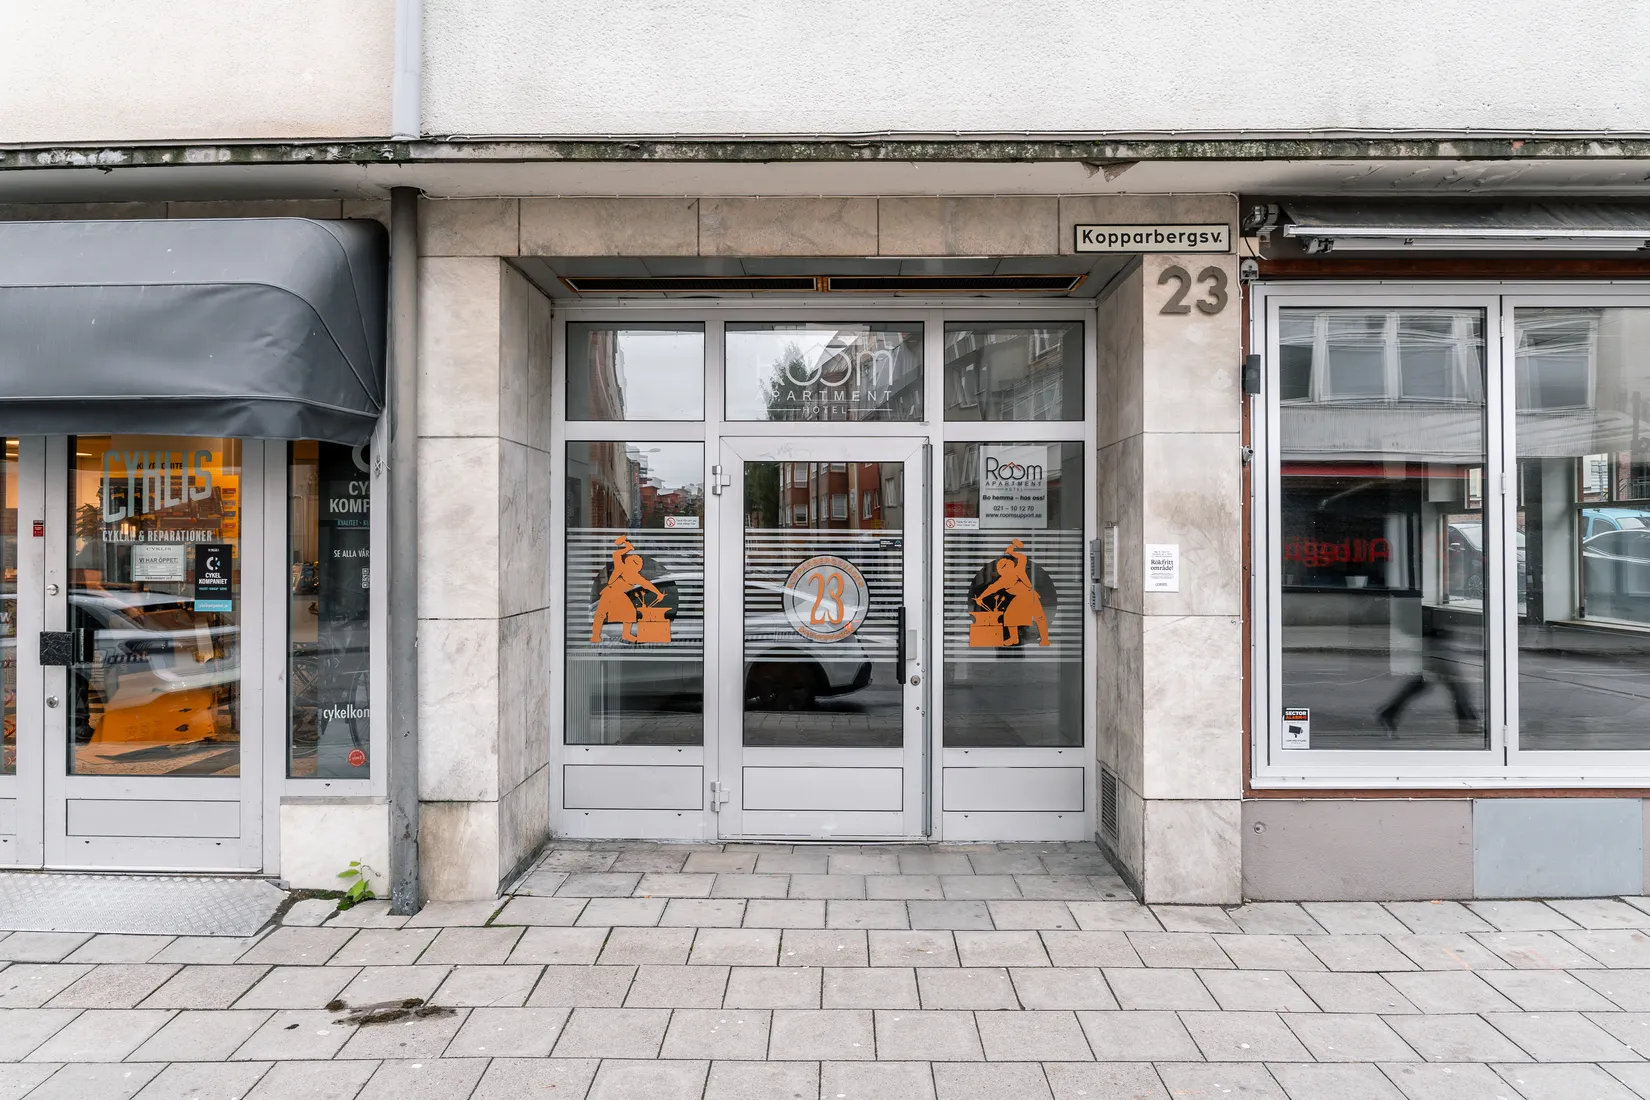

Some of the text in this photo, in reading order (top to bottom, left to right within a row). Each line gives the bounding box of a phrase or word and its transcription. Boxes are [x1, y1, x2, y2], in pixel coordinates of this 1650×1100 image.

[1082, 229, 1222, 247] Kopparbergsv.
[1157, 265, 1228, 315] 23
[802, 406, 847, 414] HOTEL
[985, 457, 1042, 480] Room
[147, 530, 212, 542] REPARATIONER
[808, 572, 844, 625] 23
